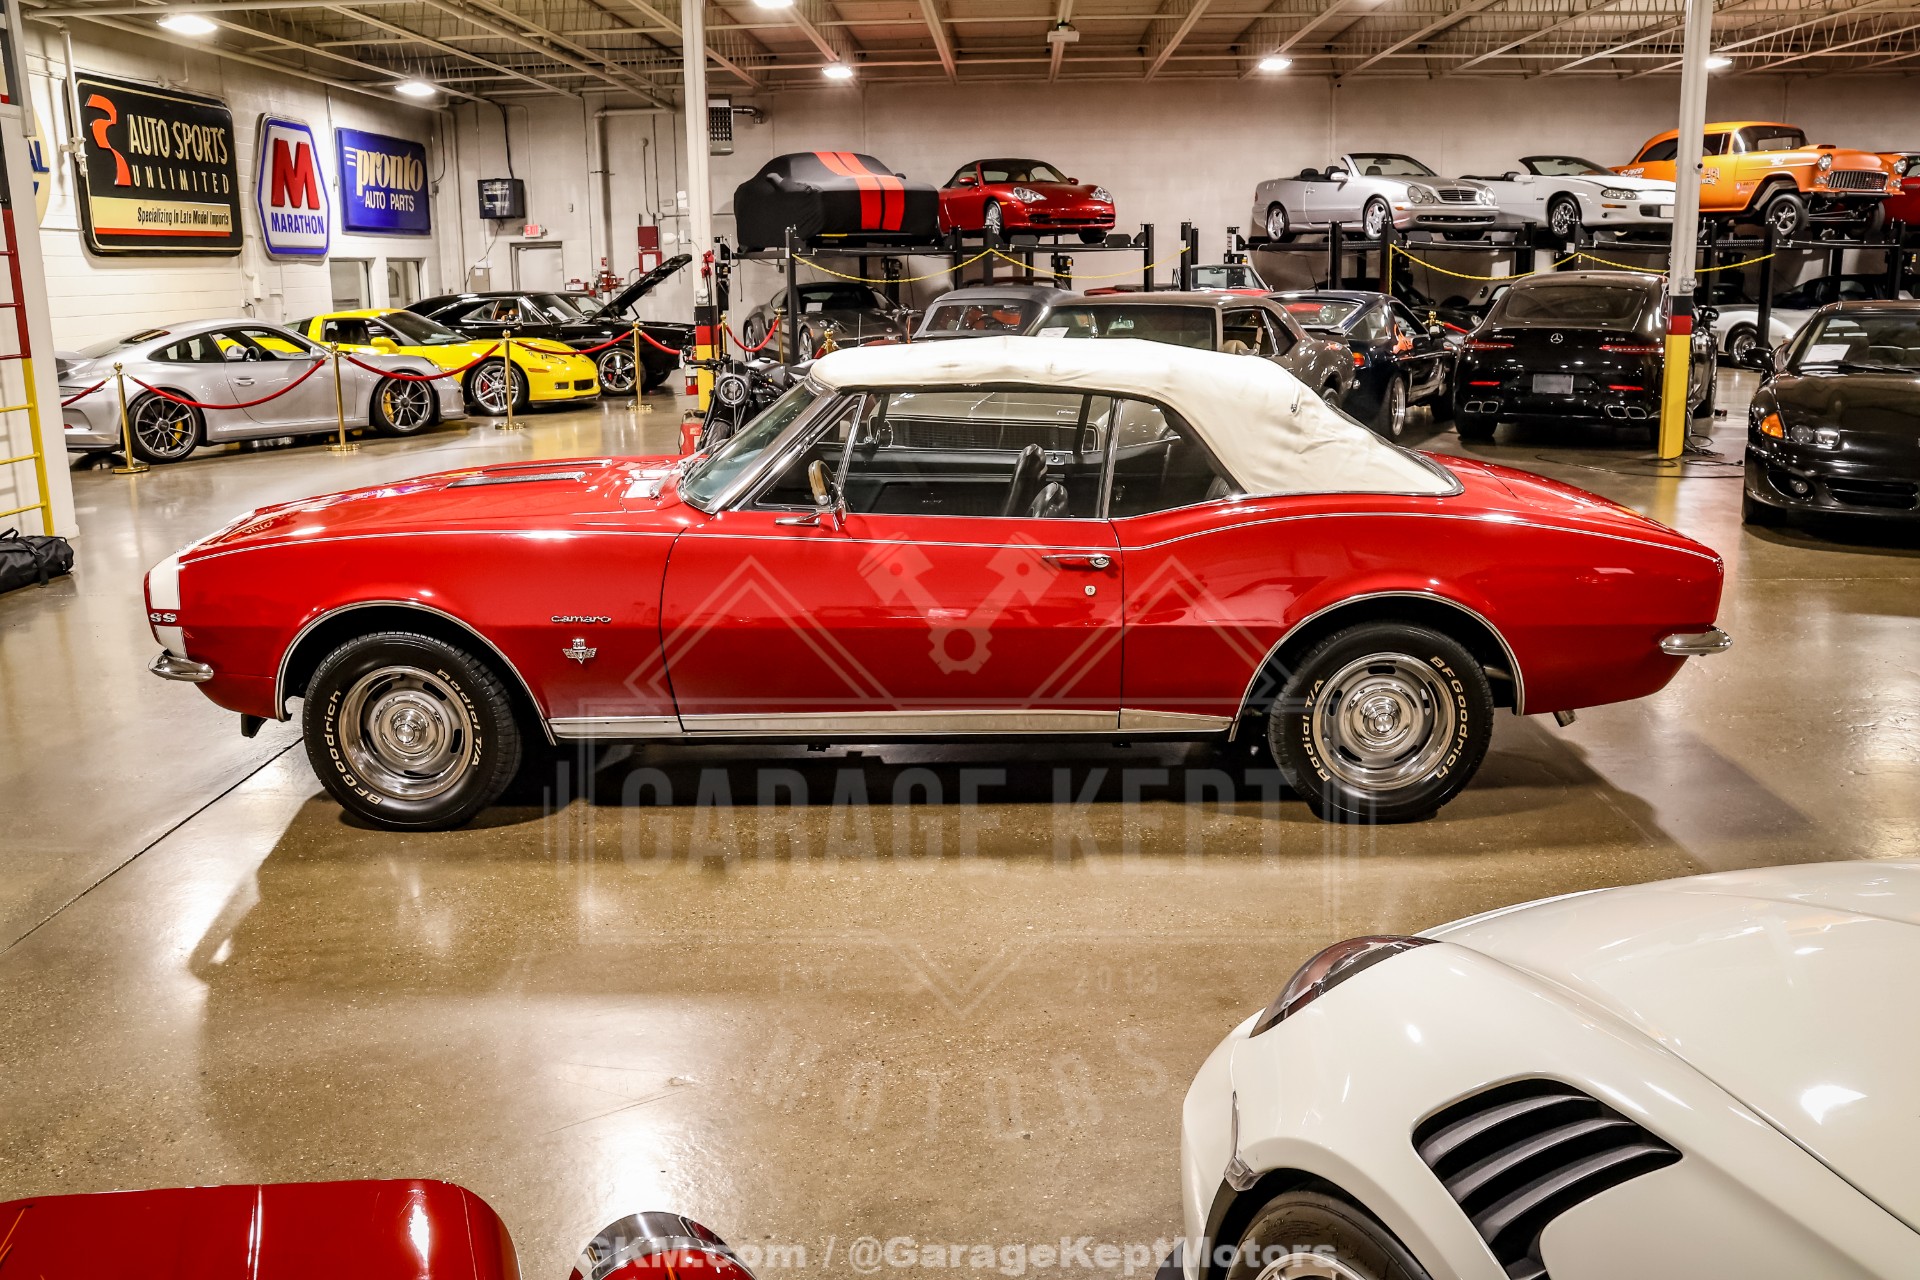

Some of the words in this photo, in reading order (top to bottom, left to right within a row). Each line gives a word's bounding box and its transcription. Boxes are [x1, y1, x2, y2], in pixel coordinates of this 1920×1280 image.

[127, 114, 170, 158] AUTO
[172, 121, 228, 165] SPORTS
[131, 164, 229, 194] UNLIMITED
[271, 138, 320, 210] M
[355, 149, 424, 197] pronto
[137, 206, 172, 226] Specializing
[180, 210, 192, 224] Late
[193, 209, 208, 225] Model
[209, 211, 229, 227] Imports
[365, 190, 386, 210] AUTO
[390, 194, 415, 212] PARTS
[271, 212, 325, 235] MARATHON
[525, 225, 539, 236] EXIT
[150, 612, 177, 623] SS
[1304, 679, 1325, 709] T/A
[437, 668, 481, 731] Radial
[471, 736, 483, 767] T/A
[1429, 655, 1468, 780] BFGoodrich
[323, 690, 384, 806] BFGoodrich
[1302, 714, 1332, 782] Radial
